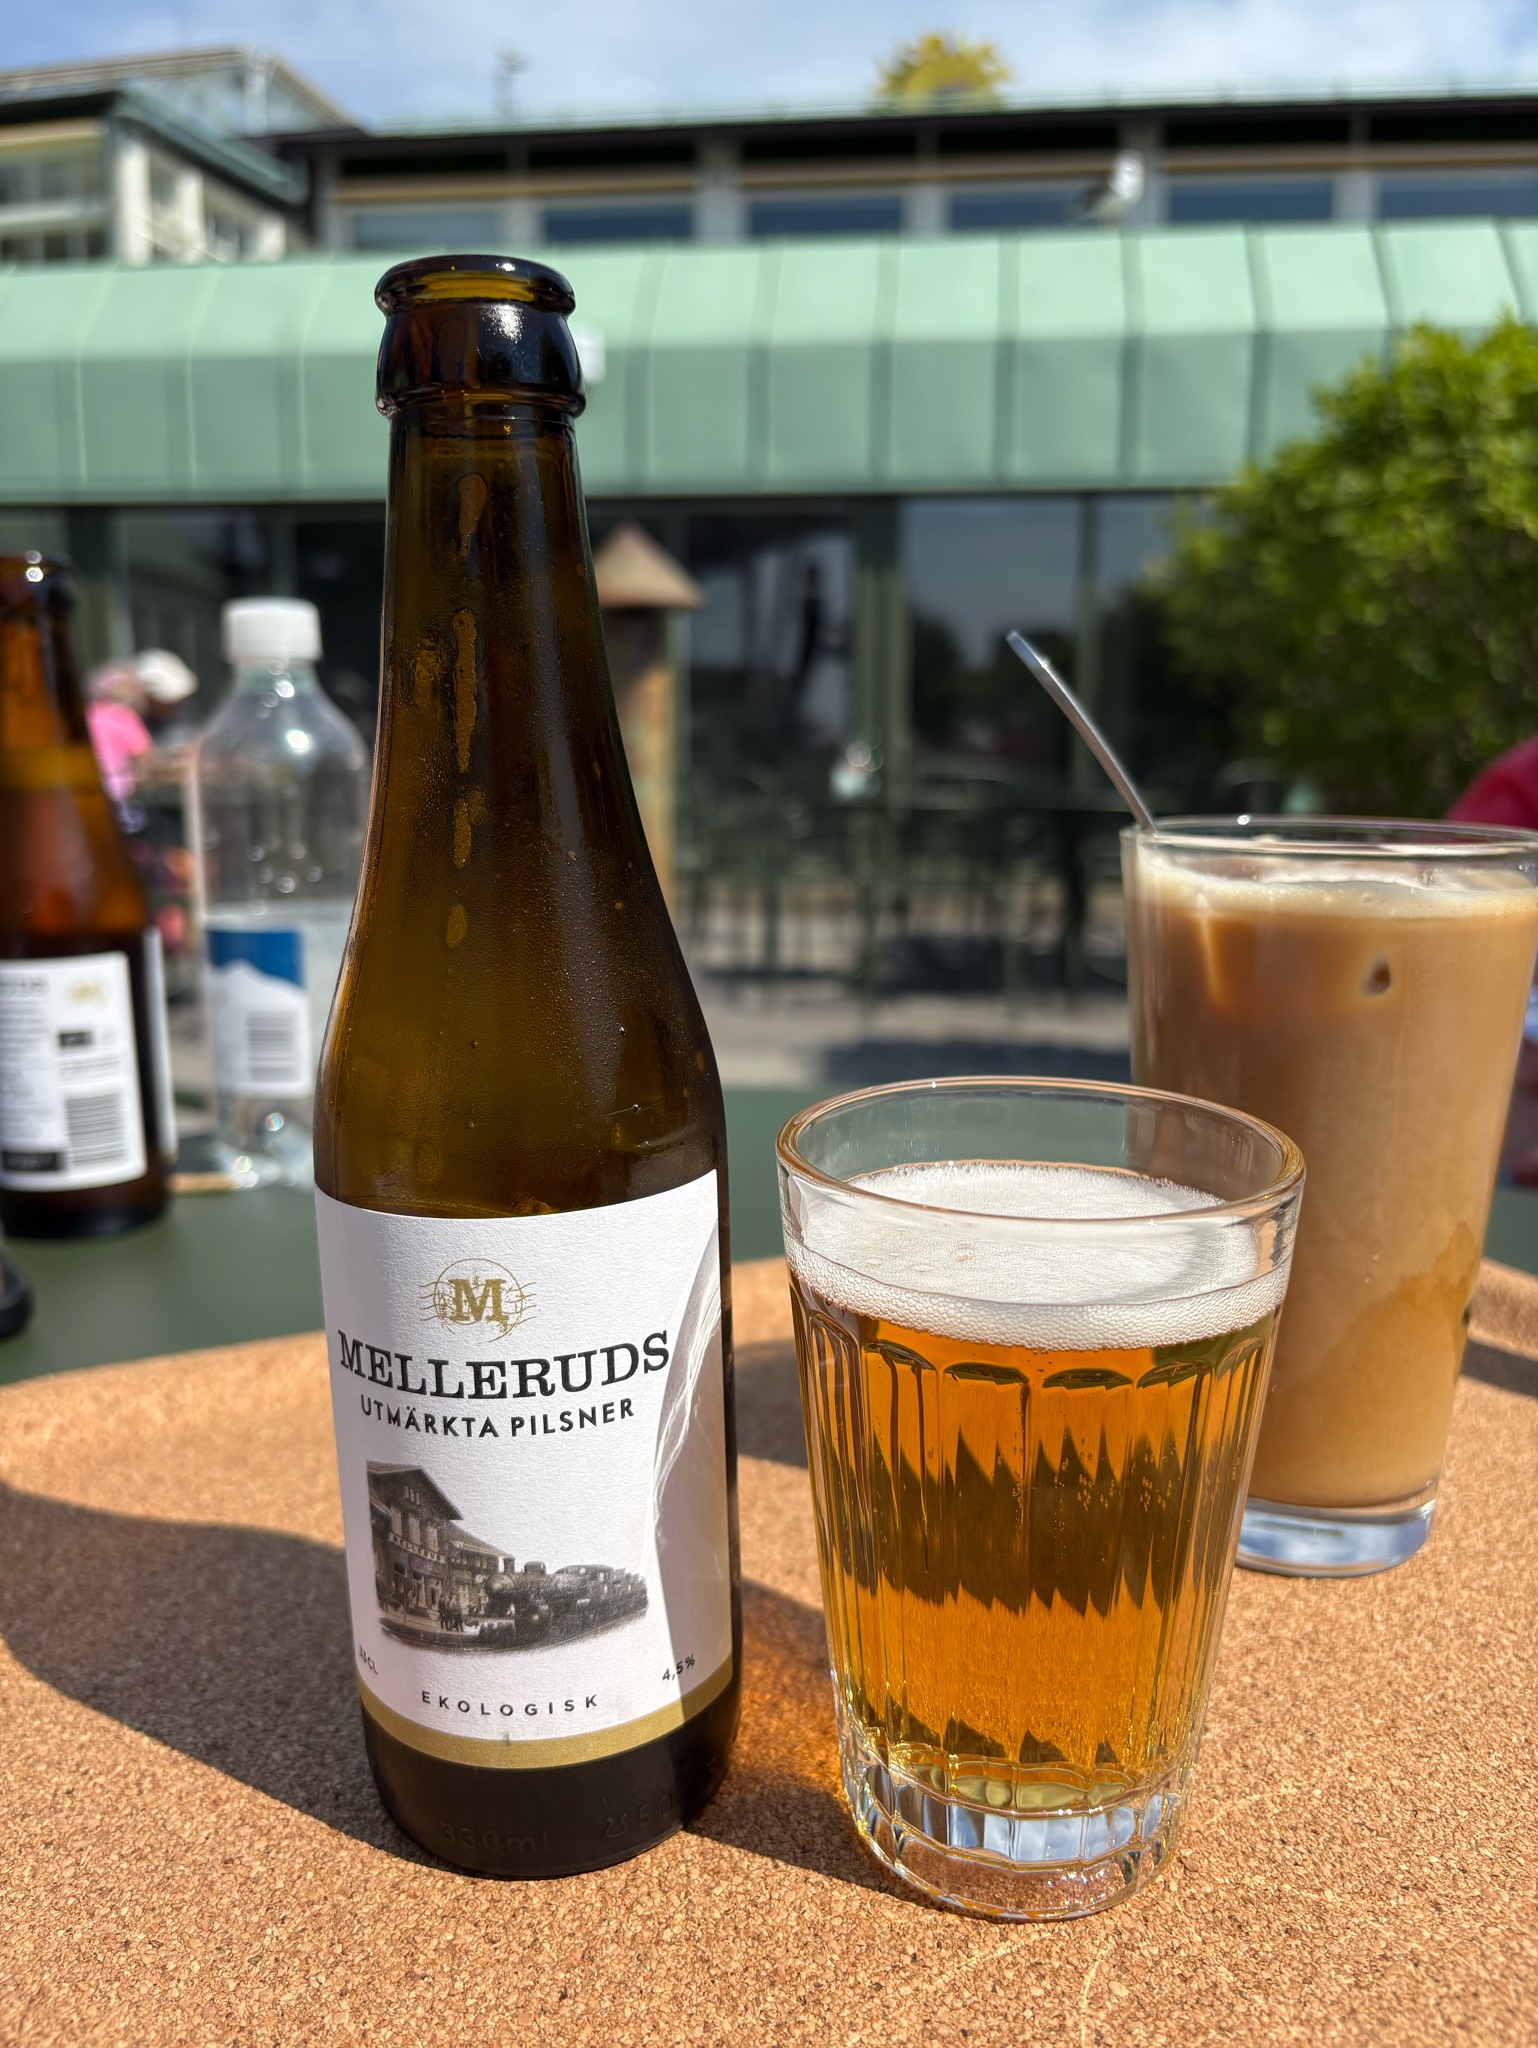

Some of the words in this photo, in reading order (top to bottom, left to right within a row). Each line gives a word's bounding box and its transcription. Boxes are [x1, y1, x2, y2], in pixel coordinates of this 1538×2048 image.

[447, 1278, 510, 1322] M
[337, 1330, 670, 1400] MELLERUDS
[361, 1394, 500, 1438] UTMÄRKTA
[511, 1398, 635, 1437] PILSNER
[661, 1652, 696, 1681] 4,5%
[421, 1690, 600, 1717] EKOLOGISK
